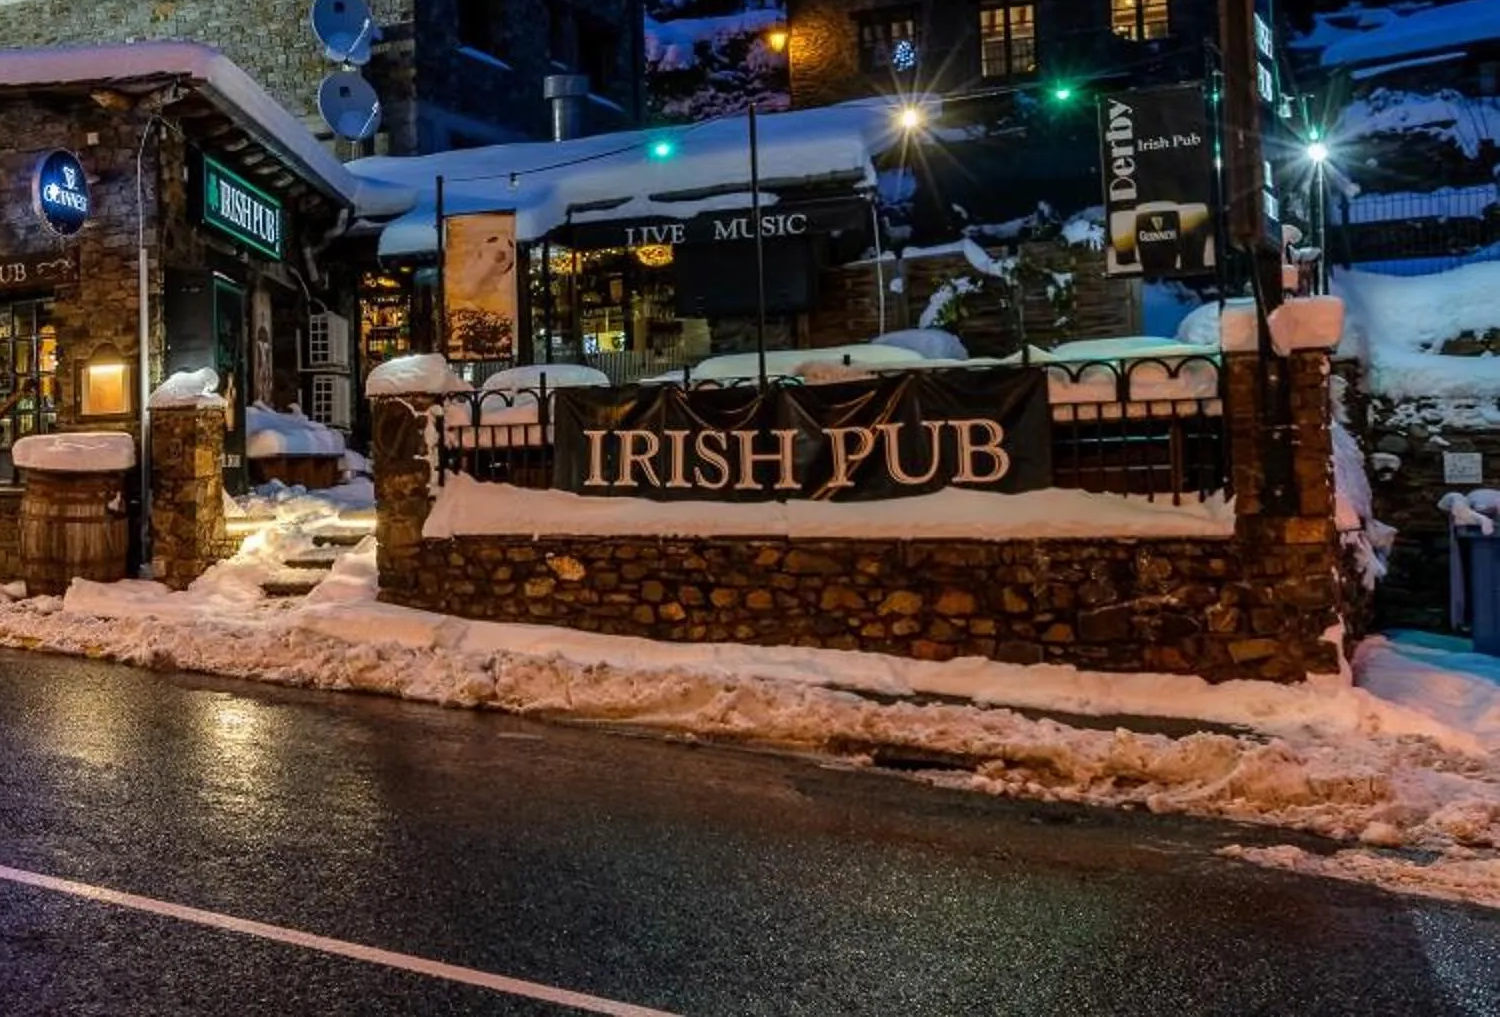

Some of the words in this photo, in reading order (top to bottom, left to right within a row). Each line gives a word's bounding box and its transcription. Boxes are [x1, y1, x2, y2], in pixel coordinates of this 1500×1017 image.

[1105, 98, 1137, 201] Derby
[1137, 136, 1170, 152] Irish
[1173, 133, 1201, 148] Pub
[252, 200, 275, 243] PUB
[624, 224, 687, 247] LIVE
[713, 214, 807, 241] MUSIC
[583, 429, 803, 491] IRISH
[821, 418, 1011, 488] PUB
